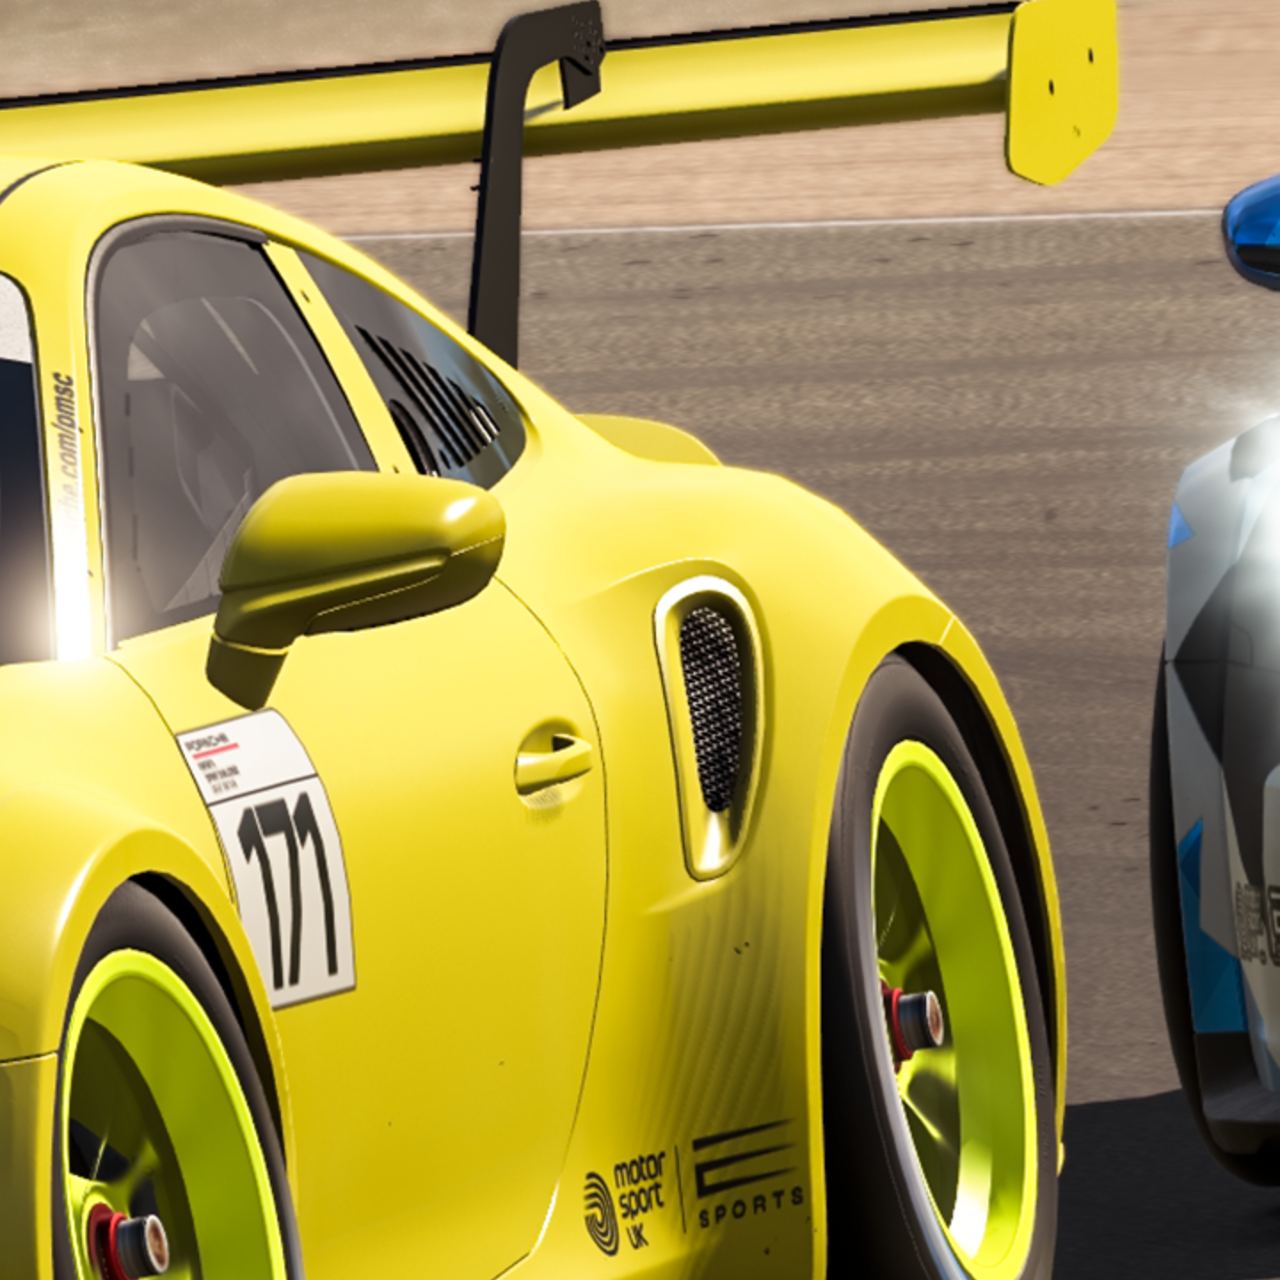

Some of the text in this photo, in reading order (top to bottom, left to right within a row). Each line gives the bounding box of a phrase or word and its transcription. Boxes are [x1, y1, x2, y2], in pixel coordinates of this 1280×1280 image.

[237, 791, 338, 990] 171
[614, 1151, 665, 1189] motor
[619, 1182, 664, 1220] sport
[699, 1186, 804, 1228] SPORTS
[626, 1223, 649, 1250] UK
